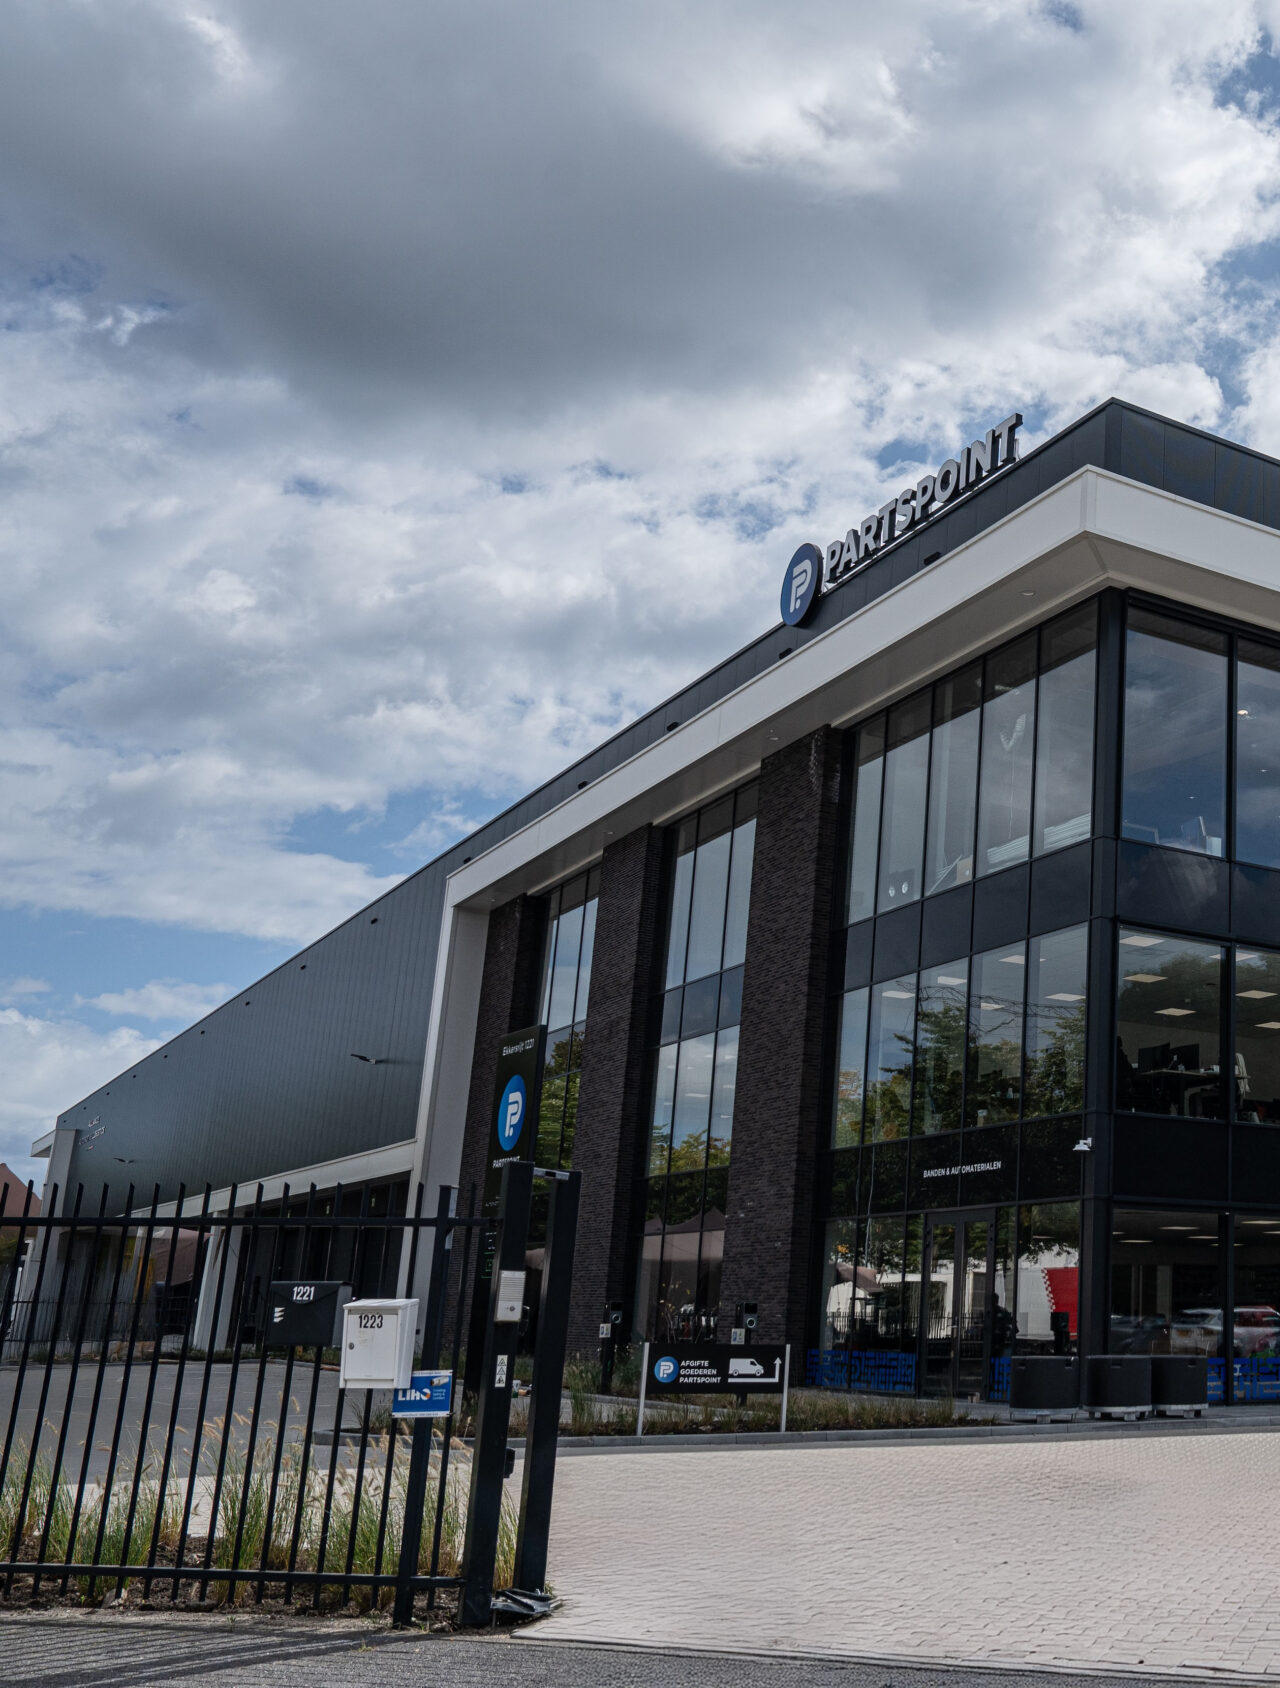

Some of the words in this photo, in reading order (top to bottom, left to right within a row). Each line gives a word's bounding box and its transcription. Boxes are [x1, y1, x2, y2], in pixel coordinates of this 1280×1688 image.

[824, 412, 1023, 584] PARTSPOINT
[923, 1168, 945, 1178] BANDEN
[946, 1167, 950, 1175] &
[292, 1286, 315, 1300] 1221
[358, 1314, 384, 1329] 1223
[398, 1388, 431, 1401] LIHO
